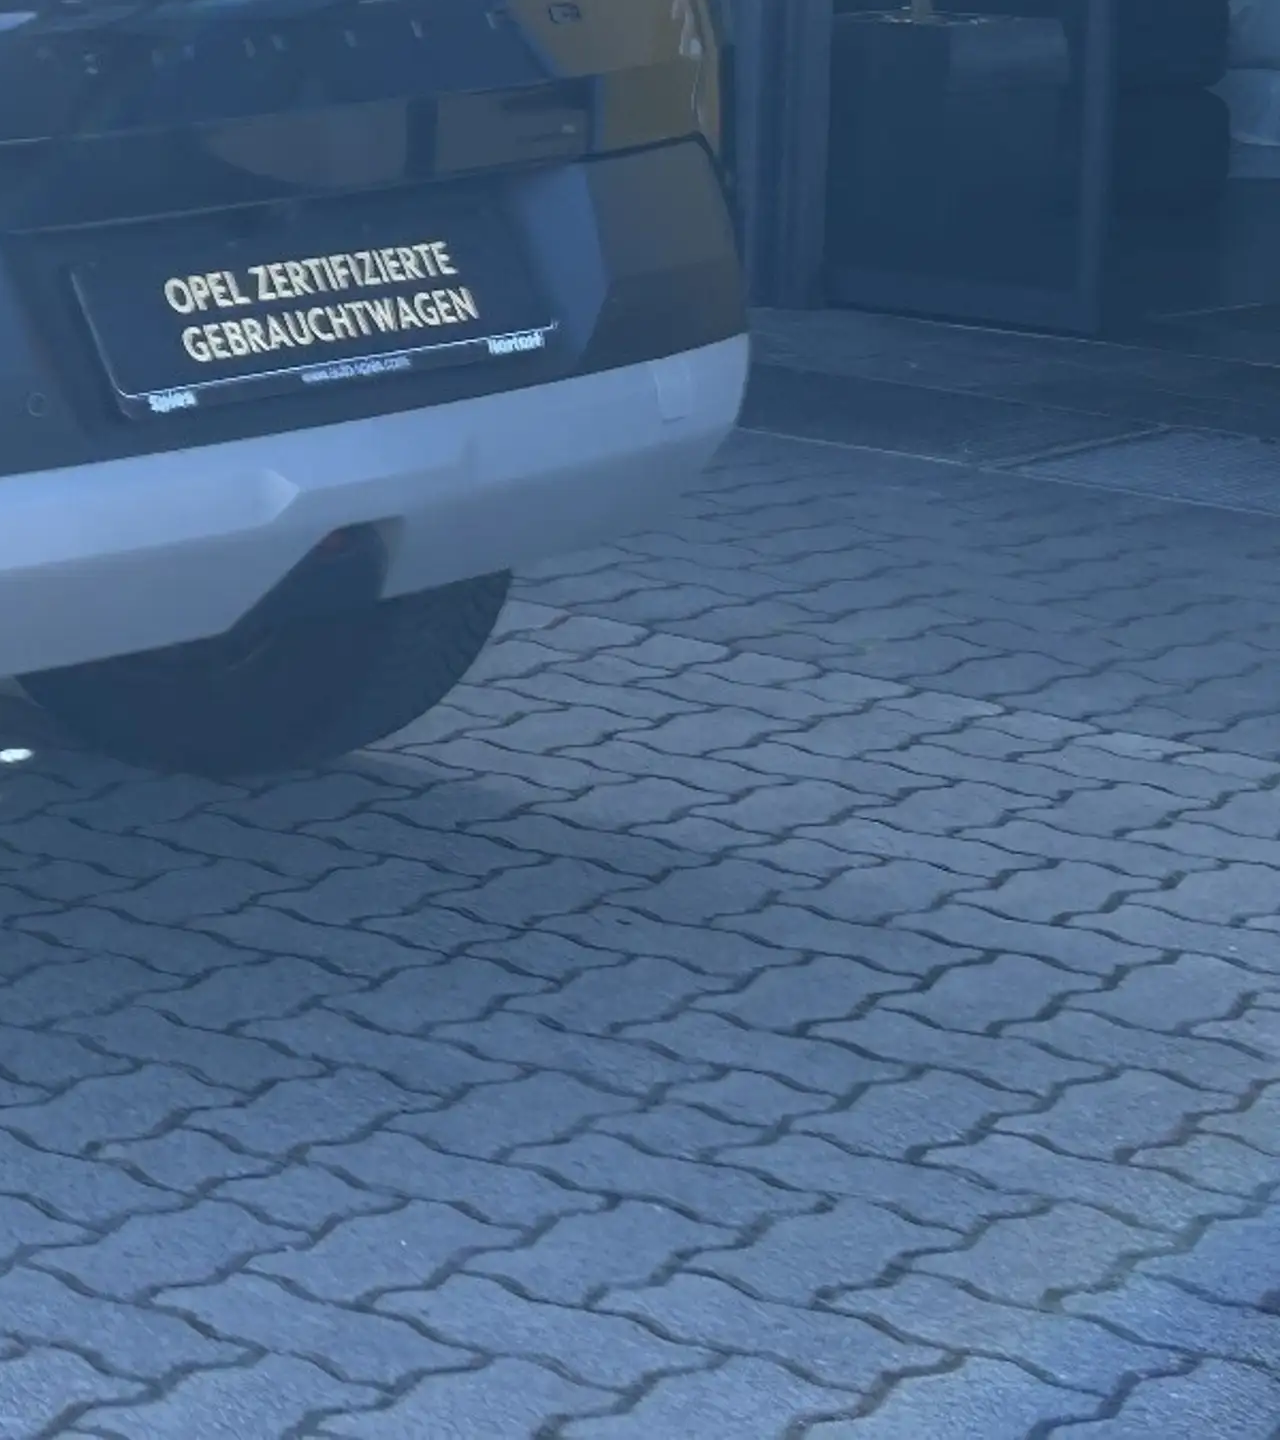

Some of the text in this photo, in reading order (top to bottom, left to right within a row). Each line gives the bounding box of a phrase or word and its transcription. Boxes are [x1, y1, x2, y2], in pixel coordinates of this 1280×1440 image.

[163, 240, 459, 315] OPEL ZERTIFIZIERTE
[180, 285, 481, 362] GEBRAUCHTWAGEN
